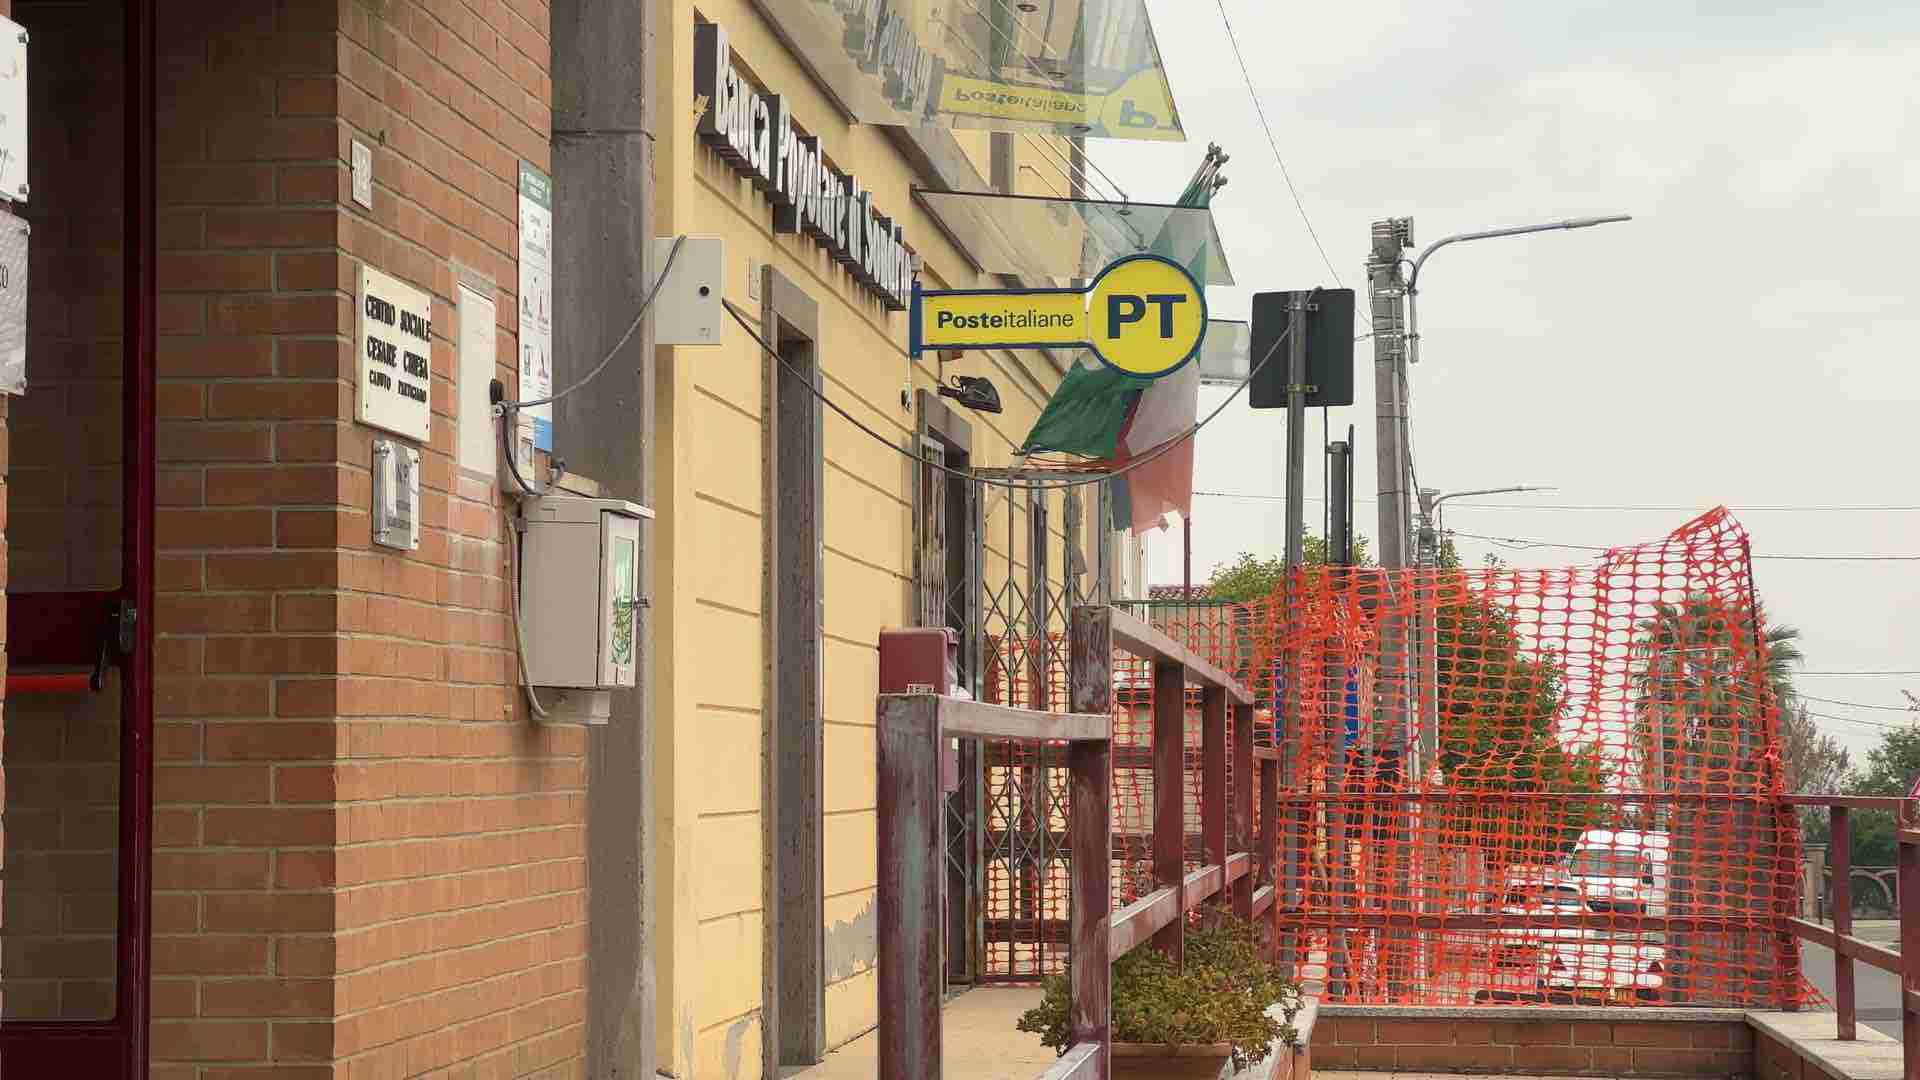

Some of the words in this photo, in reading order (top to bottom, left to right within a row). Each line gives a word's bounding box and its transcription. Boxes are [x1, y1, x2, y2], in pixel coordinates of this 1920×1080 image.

[715, 24, 770, 181] Banca
[776, 93, 846, 250] Popolare
[849, 175, 863, 265] di
[865, 191, 912, 311] Sondrio
[366, 295, 396, 327] CENTRO
[400, 309, 432, 342] SOCIALE
[937, 309, 1074, 329] Posteitaliane
[1107, 294, 1187, 340] PT
[367, 336, 397, 368] CESARE
[403, 350, 429, 380] CHIESA
